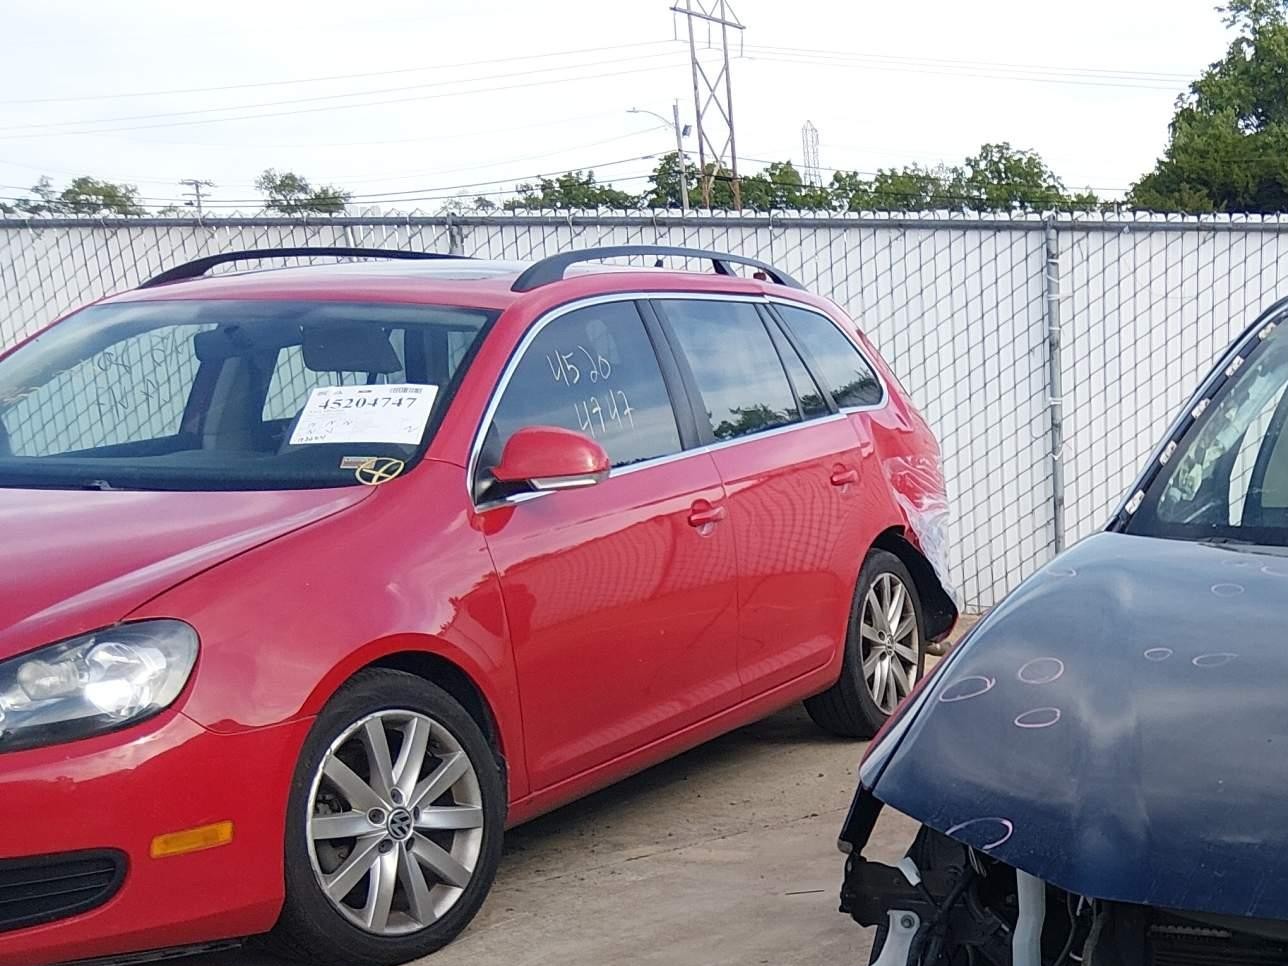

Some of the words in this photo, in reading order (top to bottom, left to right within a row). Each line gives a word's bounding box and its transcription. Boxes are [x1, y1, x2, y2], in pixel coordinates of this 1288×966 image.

[547, 345, 611, 387] 4520
[318, 397, 418, 410] 45204747
[574, 389, 635, 439] 4747
